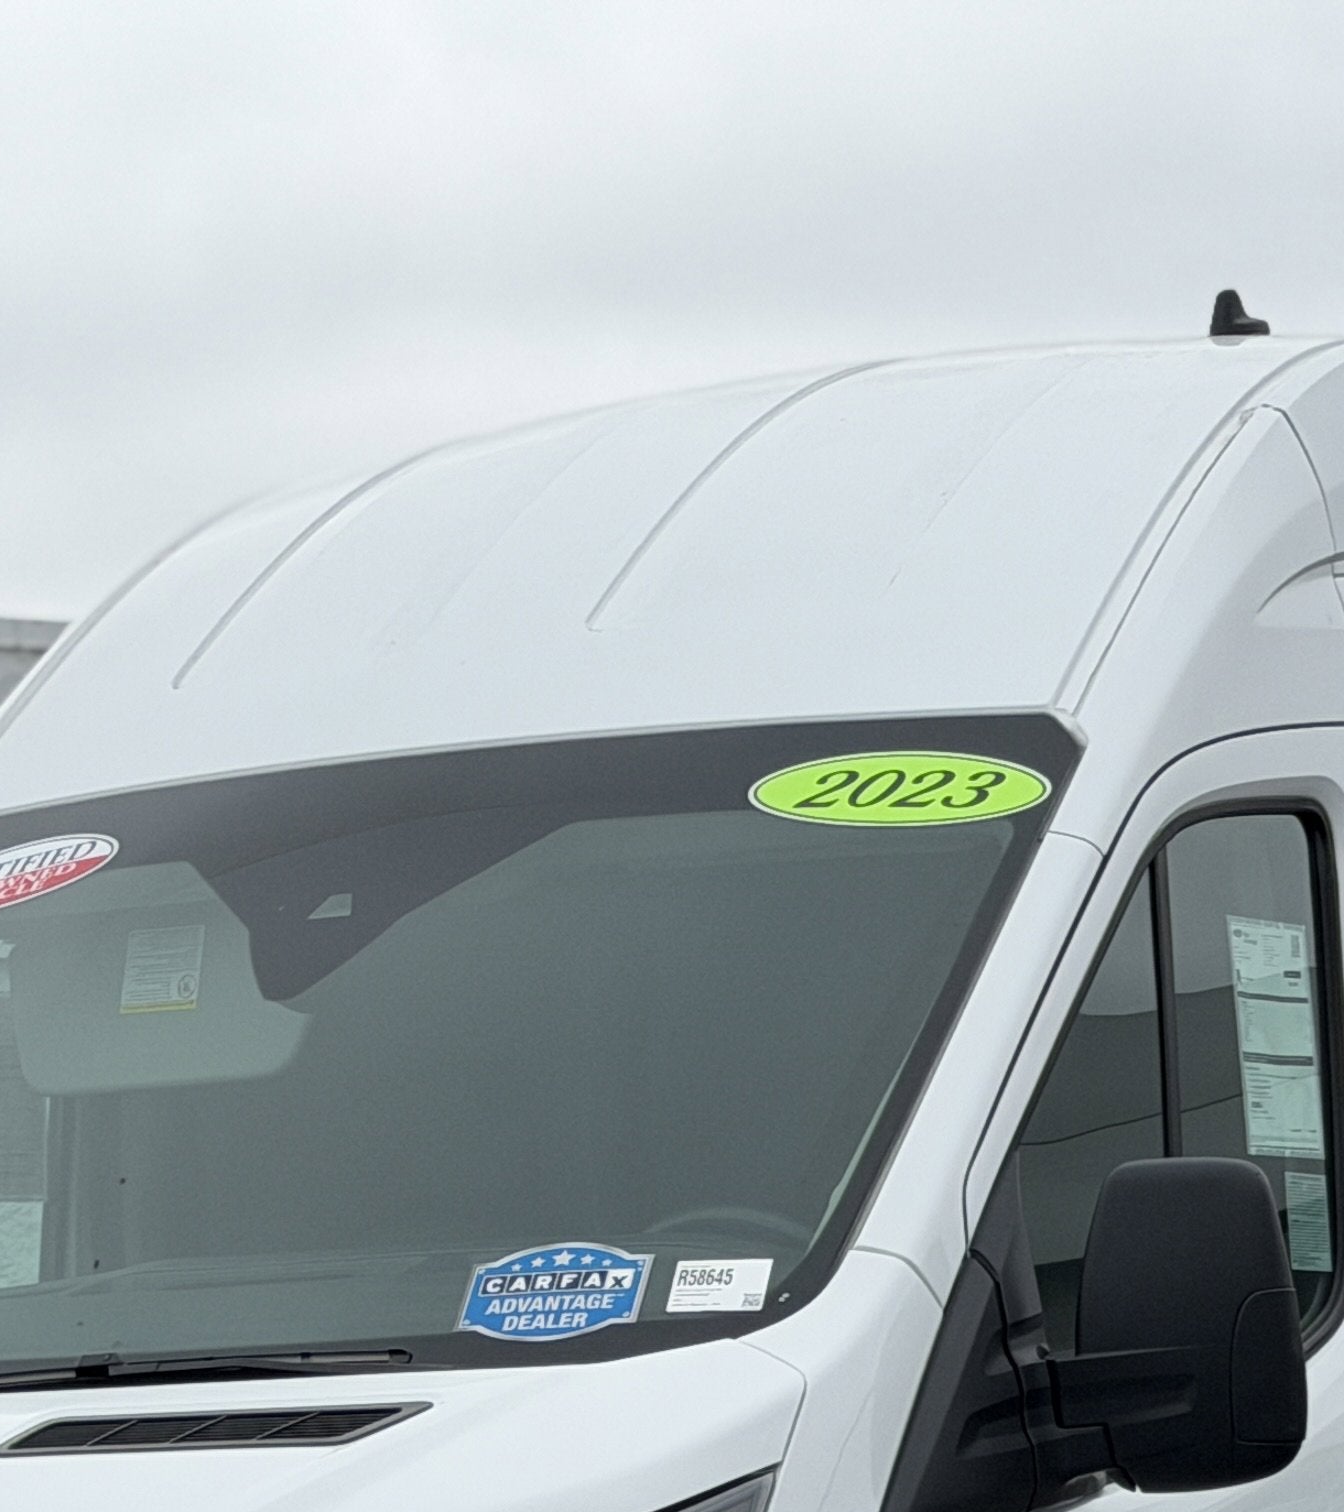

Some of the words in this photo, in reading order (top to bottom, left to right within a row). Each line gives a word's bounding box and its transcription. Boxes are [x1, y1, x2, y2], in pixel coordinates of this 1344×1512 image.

[793, 769, 1006, 809] 2023
[483, 1269, 632, 1294] CARFAX
[676, 1268, 735, 1287] R58645
[484, 1293, 614, 1316] ADVANTAGE
[501, 1312, 587, 1332] DEALER
